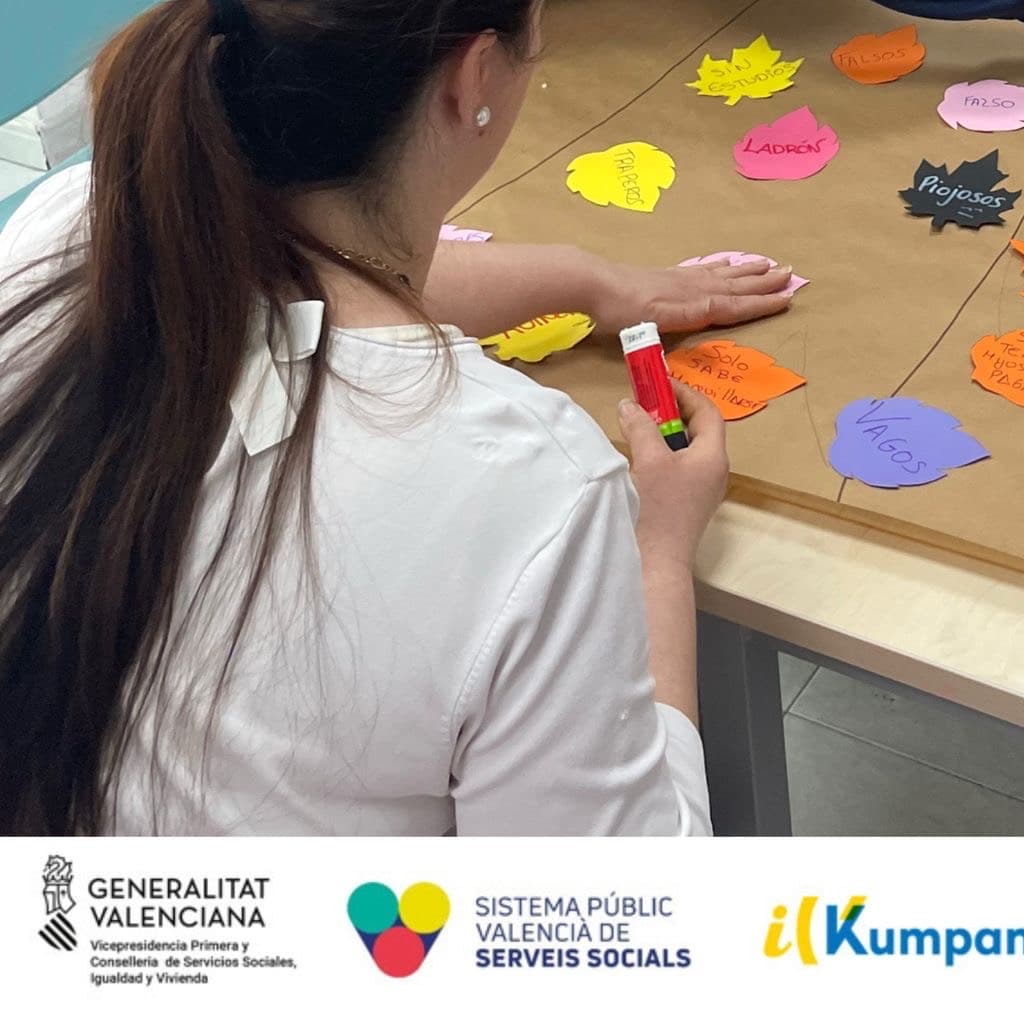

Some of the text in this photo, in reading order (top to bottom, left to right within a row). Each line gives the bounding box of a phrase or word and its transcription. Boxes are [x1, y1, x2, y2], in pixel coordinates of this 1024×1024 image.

[710, 58, 752, 77] SIN
[838, 48, 906, 68] FALSOS
[708, 63, 796, 92] ESTUDIOS
[918, 174, 1007, 210] Piojosos
[688, 358, 744, 383] SABE
[855, 399, 927, 475] VAGOS
